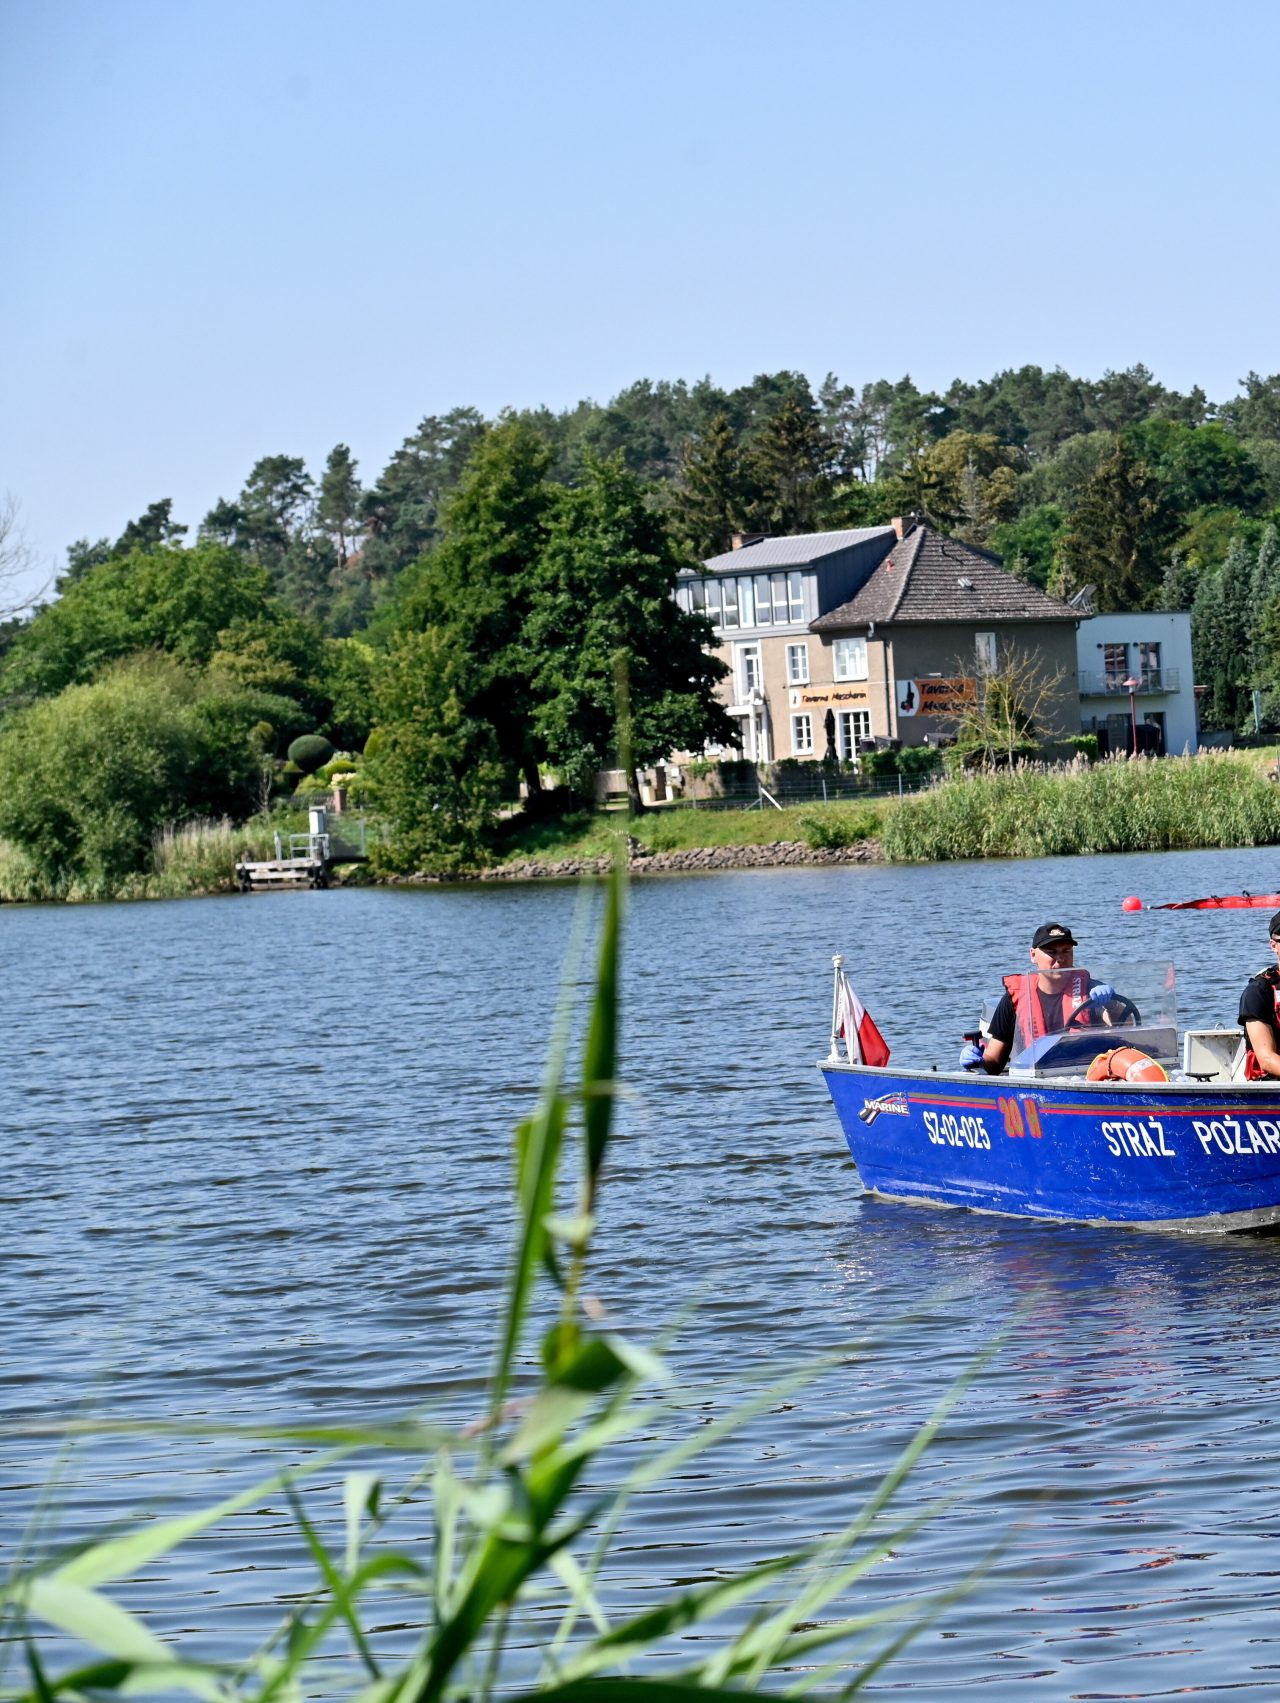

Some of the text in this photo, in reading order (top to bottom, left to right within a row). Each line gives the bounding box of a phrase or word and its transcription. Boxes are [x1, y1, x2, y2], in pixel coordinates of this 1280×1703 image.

[864, 1097, 909, 1114] MARINE
[923, 1110, 991, 1150] SZ-02-025
[1101, 1115, 1176, 1157] STRAŻ
